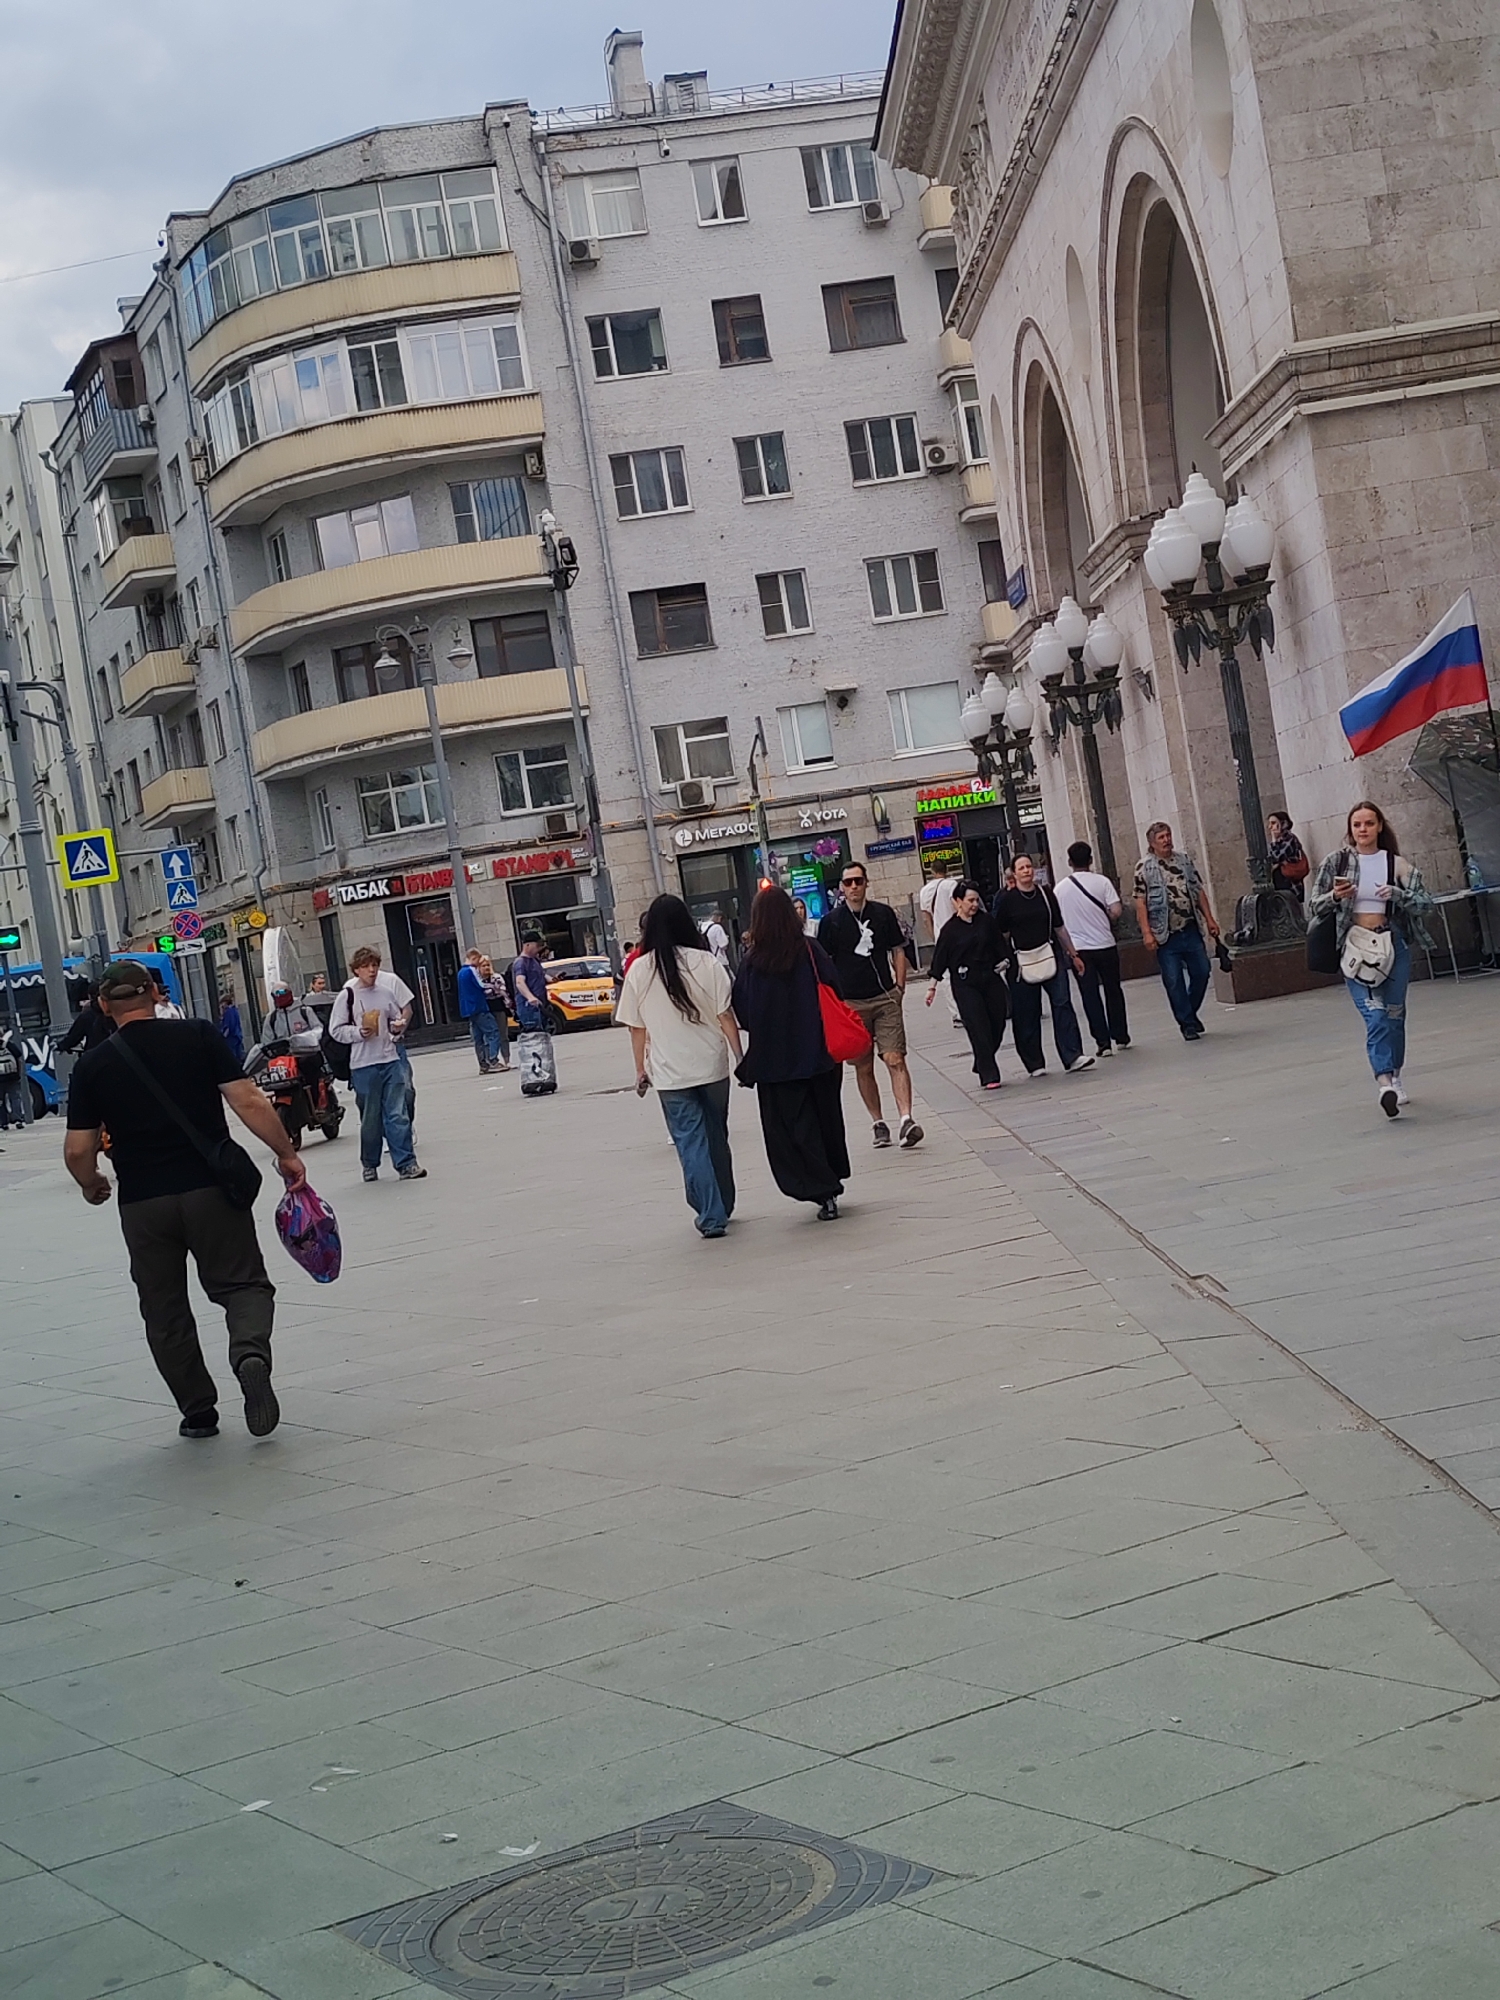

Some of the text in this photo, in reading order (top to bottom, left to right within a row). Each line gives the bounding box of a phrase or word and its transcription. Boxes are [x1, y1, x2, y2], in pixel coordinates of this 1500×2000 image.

[916, 784, 971, 801] ТАБАК
[916, 790, 997, 813] НАПИТКИ
[813, 807, 848, 822] YOTA
[695, 822, 759, 842] МЕГАФО
[406, 865, 473, 893] ISTANBL
[338, 879, 391, 903] ТАБАК
[158, 935, 175, 953] $
